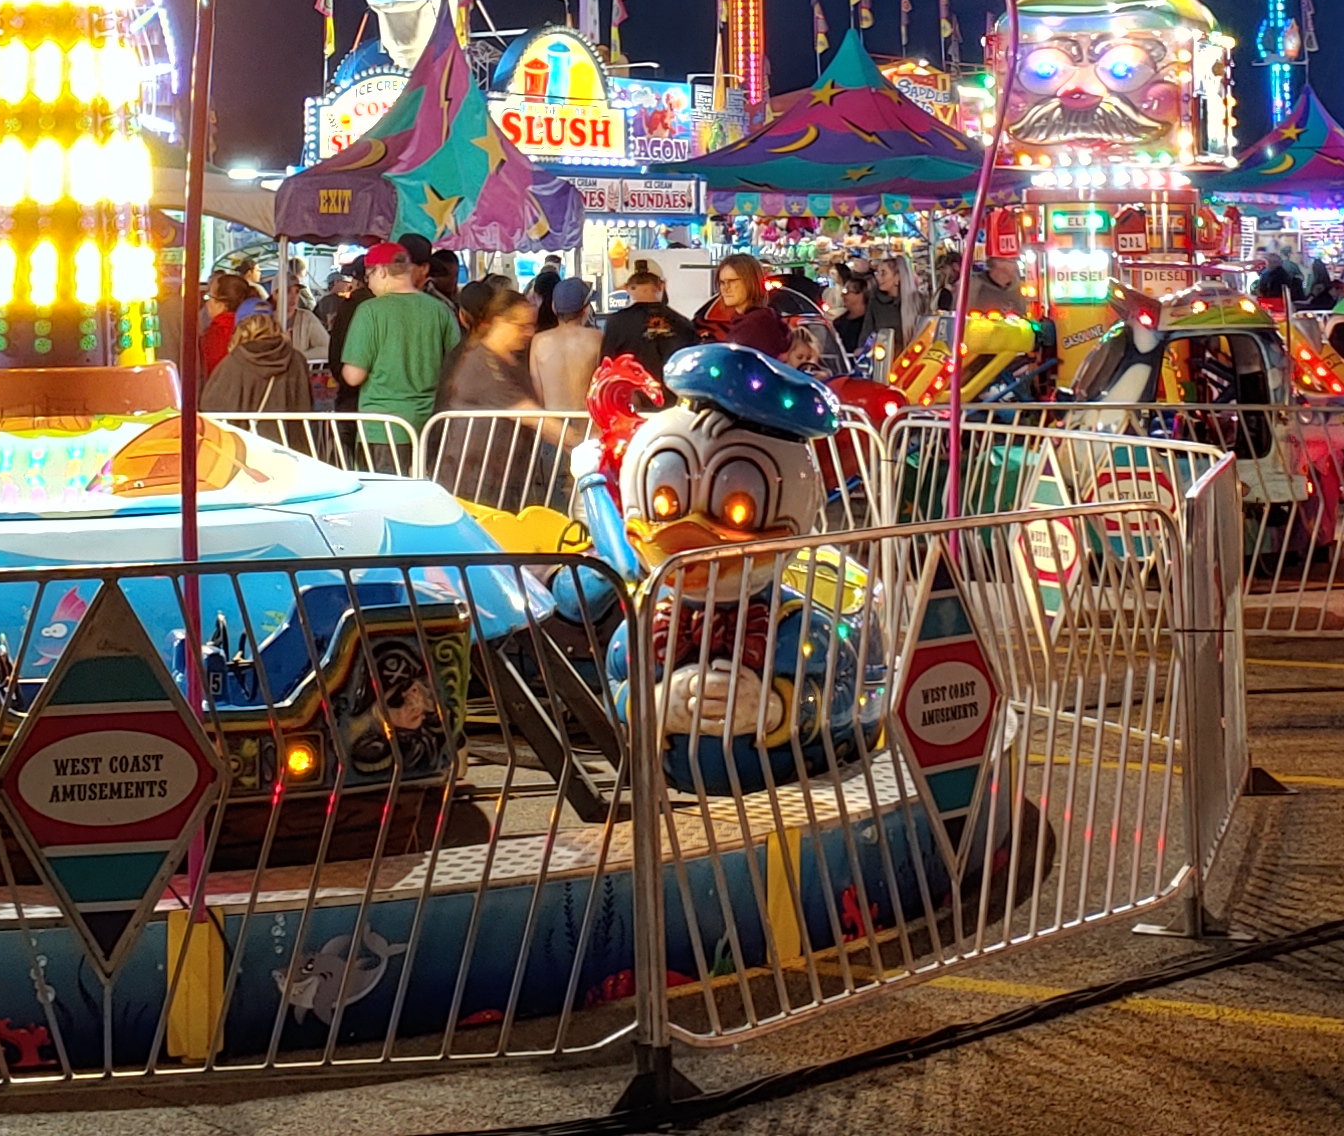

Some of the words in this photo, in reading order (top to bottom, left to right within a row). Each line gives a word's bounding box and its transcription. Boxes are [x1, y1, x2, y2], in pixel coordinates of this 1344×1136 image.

[897, 79, 951, 103] SADDLE
[502, 111, 611, 148] SLUSH
[654, 181, 672, 189] CREAM
[319, 189, 352, 214] EXIT
[628, 191, 687, 209] SUNDAES
[1119, 235, 1143, 249] OIL
[1056, 271, 1106, 282] DIESEL
[1144, 269, 1186, 282] DIESEL
[921, 685, 947, 705] WEST
[949, 680, 976, 700] COAST
[921, 701, 979, 727] AMUSEMENTS
[53, 756, 102, 777] WEST
[108, 753, 164, 774] COAST
[49, 779, 168, 804] AMUSEMENTS
